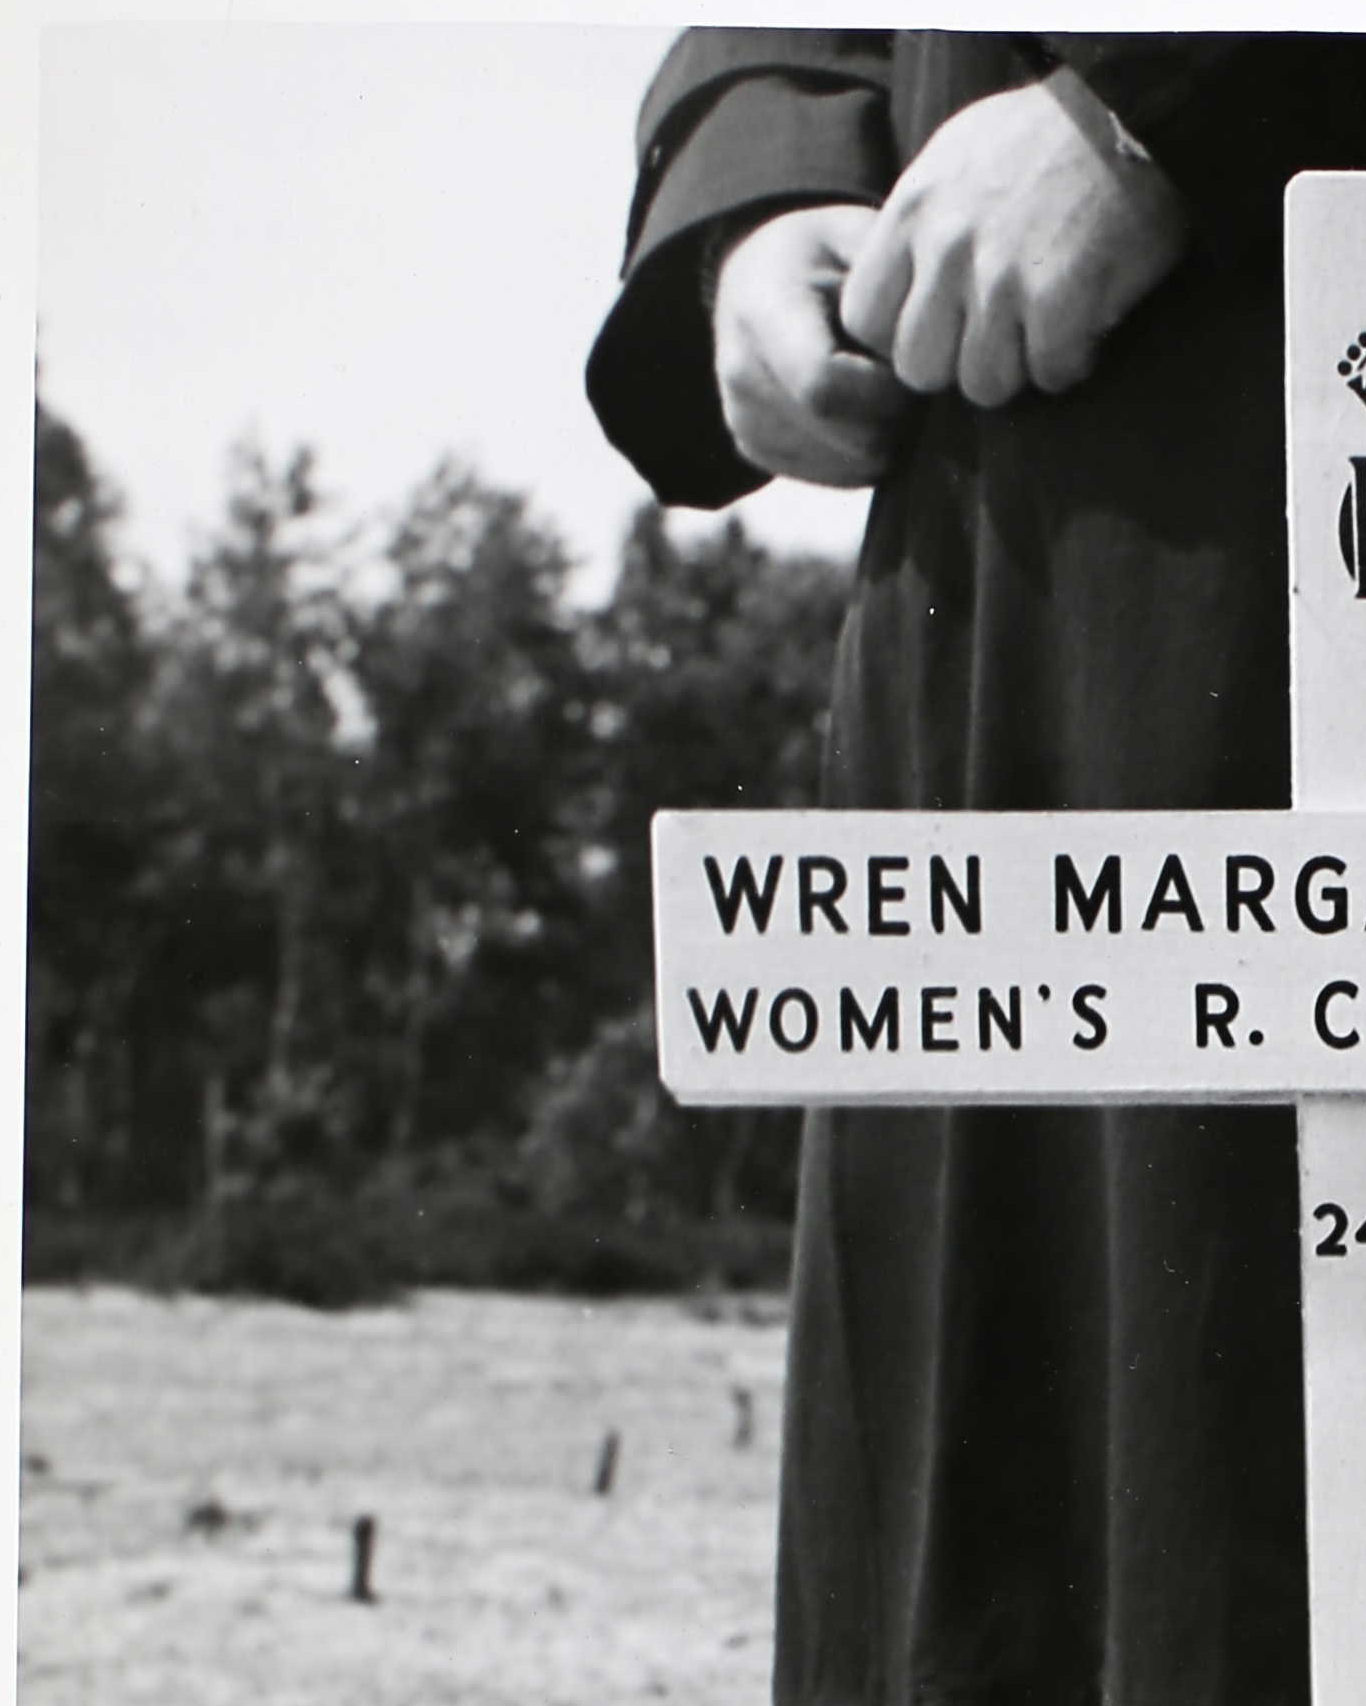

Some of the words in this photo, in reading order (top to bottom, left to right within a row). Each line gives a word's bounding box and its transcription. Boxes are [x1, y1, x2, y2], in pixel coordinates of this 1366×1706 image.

[702, 854, 983, 936] WREN
[686, 983, 1108, 1054] WOMEN'S
[1194, 982, 1265, 1050] R.
